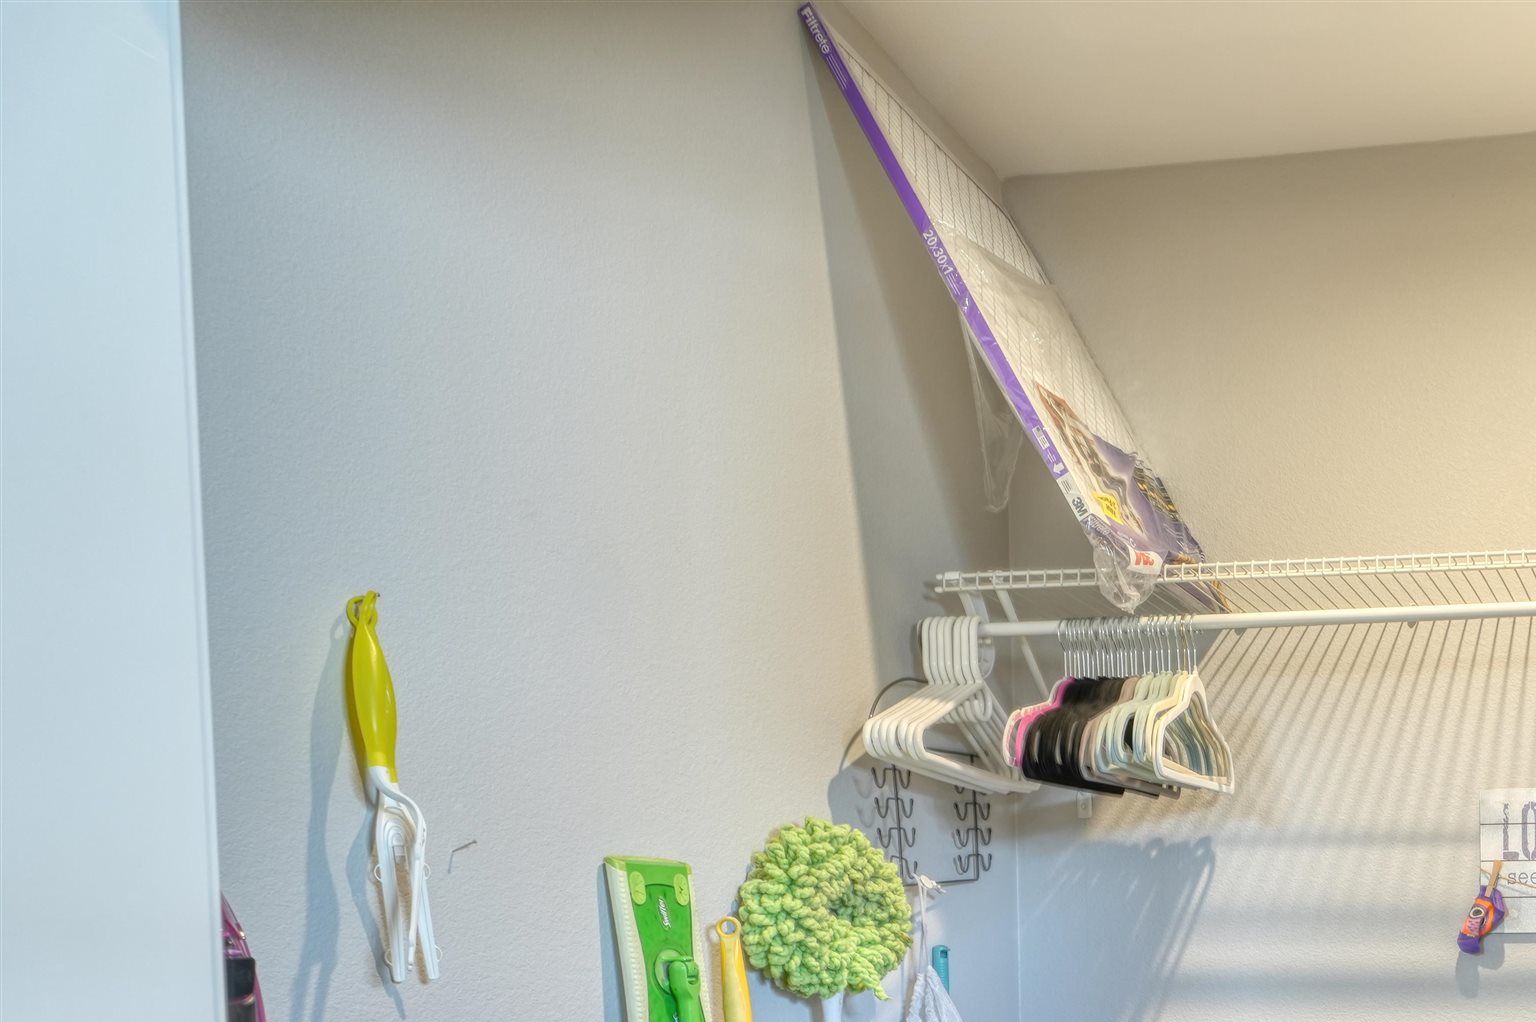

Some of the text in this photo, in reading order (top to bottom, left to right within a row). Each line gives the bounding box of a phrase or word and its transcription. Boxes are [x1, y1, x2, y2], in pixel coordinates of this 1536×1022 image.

[801, 6, 830, 54] Filtrete
[923, 229, 954, 275] 20x30x1
[1071, 496, 1088, 517] 3M
